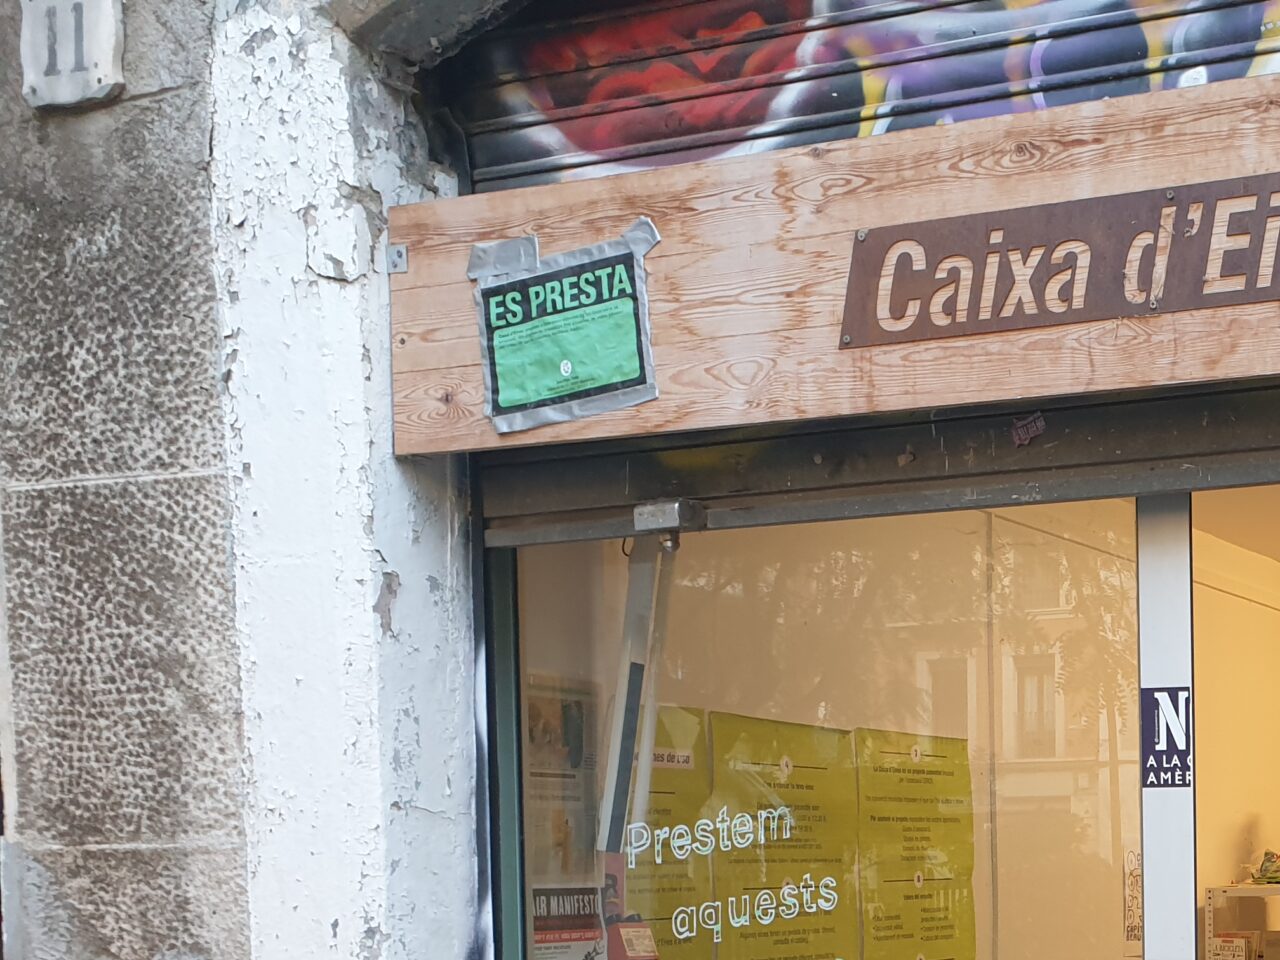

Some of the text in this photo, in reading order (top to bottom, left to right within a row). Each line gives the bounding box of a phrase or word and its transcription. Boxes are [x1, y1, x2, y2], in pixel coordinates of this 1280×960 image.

[44, 2, 88, 76] 11
[489, 291, 524, 327] ES
[529, 263, 633, 318] PRESTA
[876, 229, 1092, 333] Caixa
[1153, 691, 1189, 751] N
[1146, 754, 1157, 767] A
[1162, 754, 1181, 767] LA
[627, 805, 792, 869] Prestem
[550, 894, 600, 916] MANIFESTO
[671, 872, 838, 943] aquests
